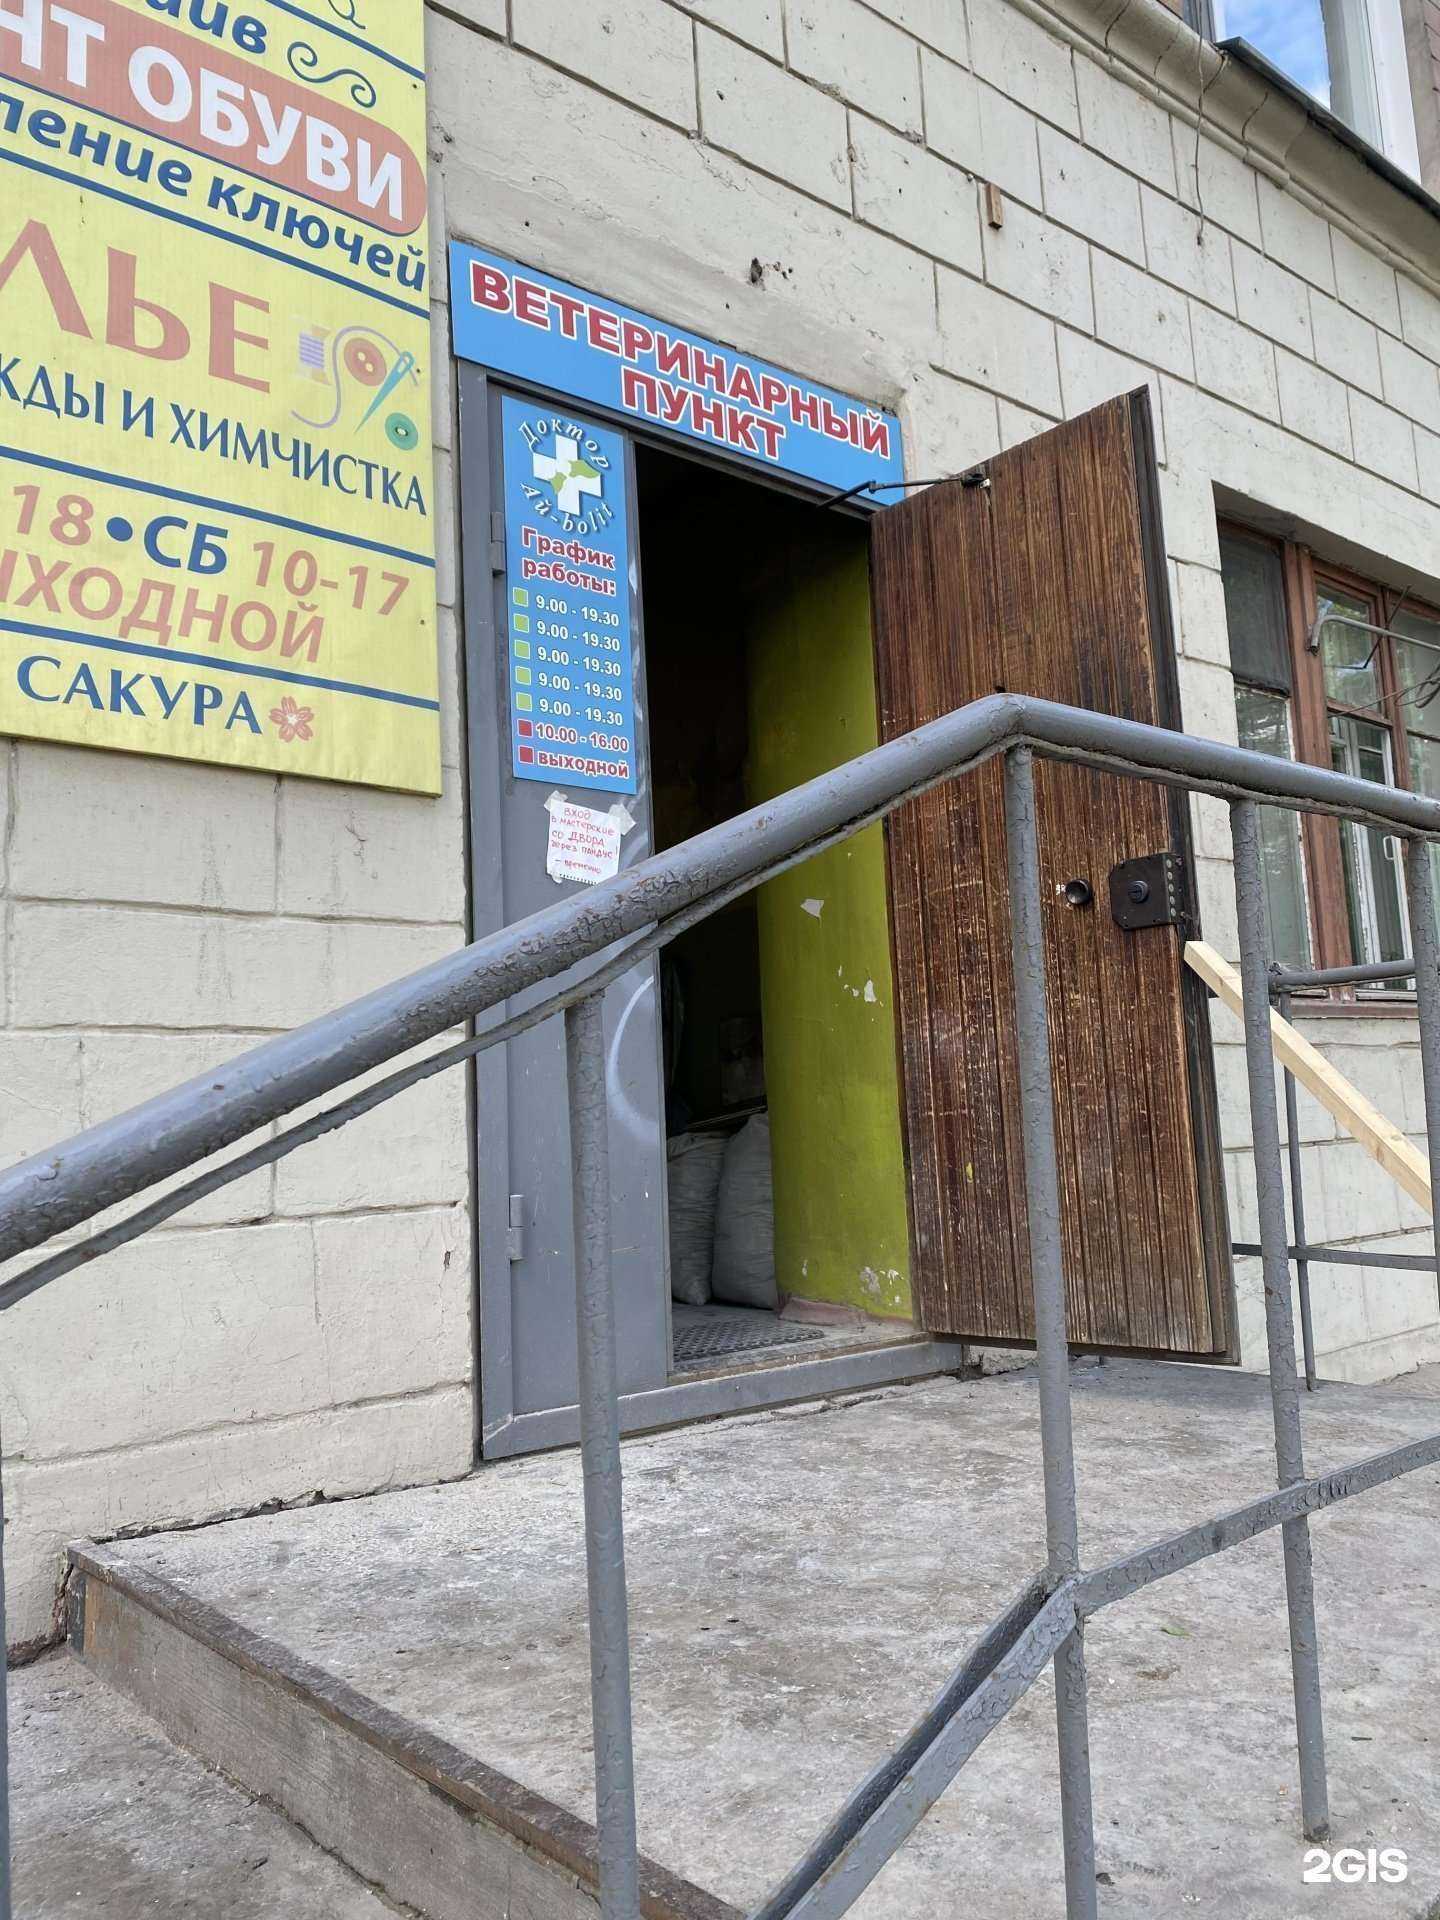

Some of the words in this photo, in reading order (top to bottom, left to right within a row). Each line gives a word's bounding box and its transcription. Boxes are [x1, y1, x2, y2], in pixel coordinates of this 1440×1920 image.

[127, 45, 403, 222] ОБУВИ
[206, 177, 426, 292] ключей
[0, 219, 271, 393] ЛЬЕ
[469, 259, 890, 459] ВЕТЕРИНАРНЫЙ
[620, 366, 786, 462] ПУНКТ
[122, 389, 154, 439] И
[169, 403, 428, 516] ХИМЧИСТКА
[518, 417, 609, 469] Доктор
[143, 514, 229, 576] СБ
[252, 541, 410, 617] 10-17
[522, 525, 615, 571] График
[522, 557, 617, 596] работы:
[535, 595, 567, 615] 9.00
[581, 607, 619, 627] 19.30
[536, 620, 568, 640] 9.00
[582, 631, 621, 652] 19.30
[537, 646, 569, 666] 9.00
[583, 657, 621, 677] 19.30
[538, 672, 570, 691] 9.00
[584, 682, 622, 702] 19.30
[17, 655, 263, 735] САКУРА
[539, 698, 571, 717] 9.00
[585, 707, 623, 726] 19.30
[536, 722, 577, 744] 10.00
[590, 732, 629, 752] 16.00
